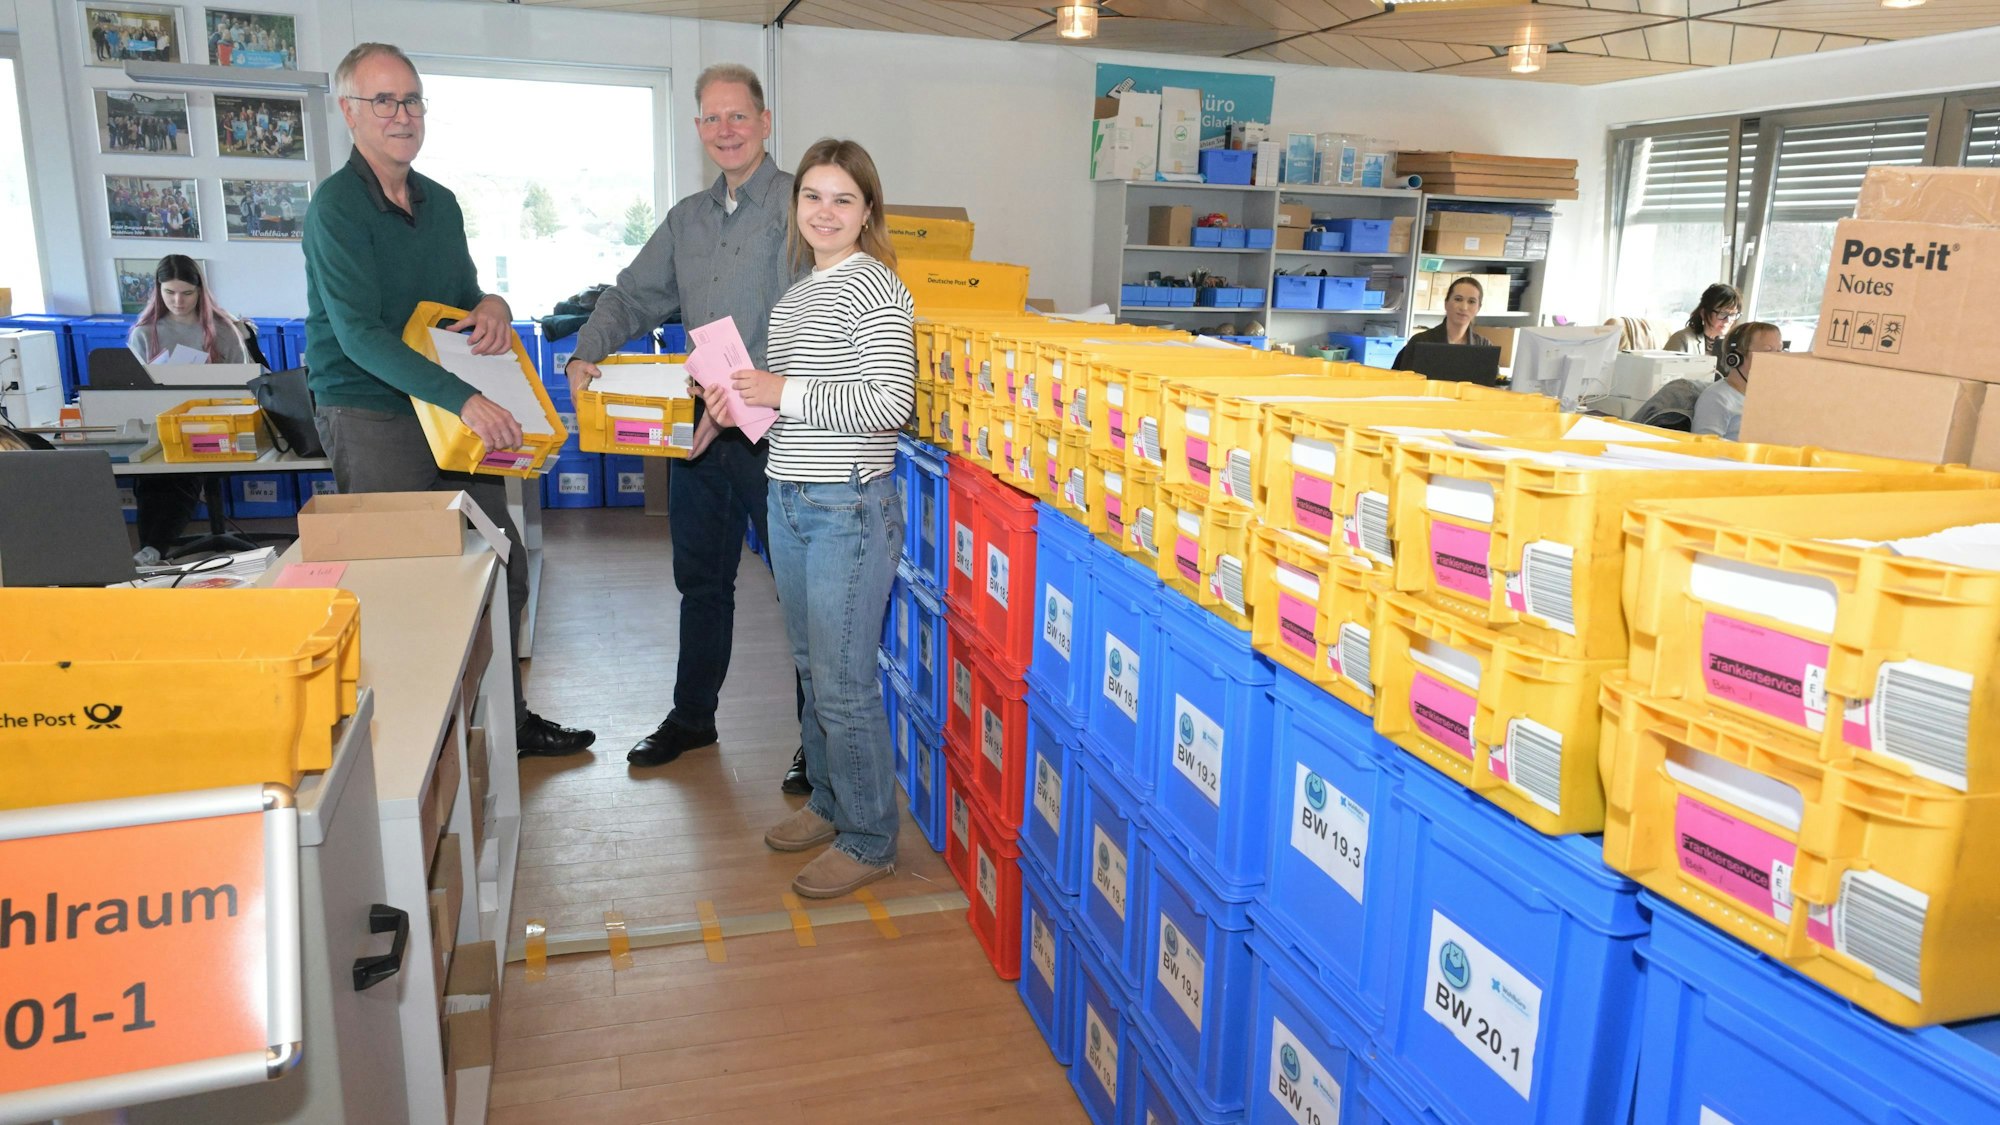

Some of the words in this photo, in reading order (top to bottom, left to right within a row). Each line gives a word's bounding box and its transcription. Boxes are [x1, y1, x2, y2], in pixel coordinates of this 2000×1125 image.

[927, 277, 953, 285] Deutsche
[1837, 274, 1894, 296] Notes
[1436, 552, 1487, 577] Frankierservice
[990, 577, 999, 594] BW
[1047, 622, 1058, 640] BW
[1058, 632, 1070, 653] 18.3
[1109, 676, 1123, 698] BW
[1124, 691, 1138, 713] 19.1
[1710, 656, 1801, 696] Frankierservice
[34, 713, 76, 726] Post
[1415, 702, 1468, 739] Frankierservice
[1178, 744, 1195, 770] BW
[1197, 761, 1216, 791] 19.2
[1037, 783, 1048, 802] BW
[1302, 806, 1328, 840] BW
[1332, 831, 1361, 868] 19.3
[1682, 836, 1769, 887] Frankierservice
[1098, 867, 1110, 891] BW
[1112, 885, 1125, 912] 19.1
[1033, 935, 1044, 958] BW
[1163, 951, 1179, 980] BW
[1181, 967, 1199, 1008] 19.2
[5, 982, 155, 1050] 01-1
[1435, 981, 1472, 1028] BW
[1476, 1018, 1520, 1071] 20.1
[1089, 1045, 1101, 1070] BW
[1103, 1067, 1116, 1092] 19.1
[1279, 1074, 1302, 1111] BW
